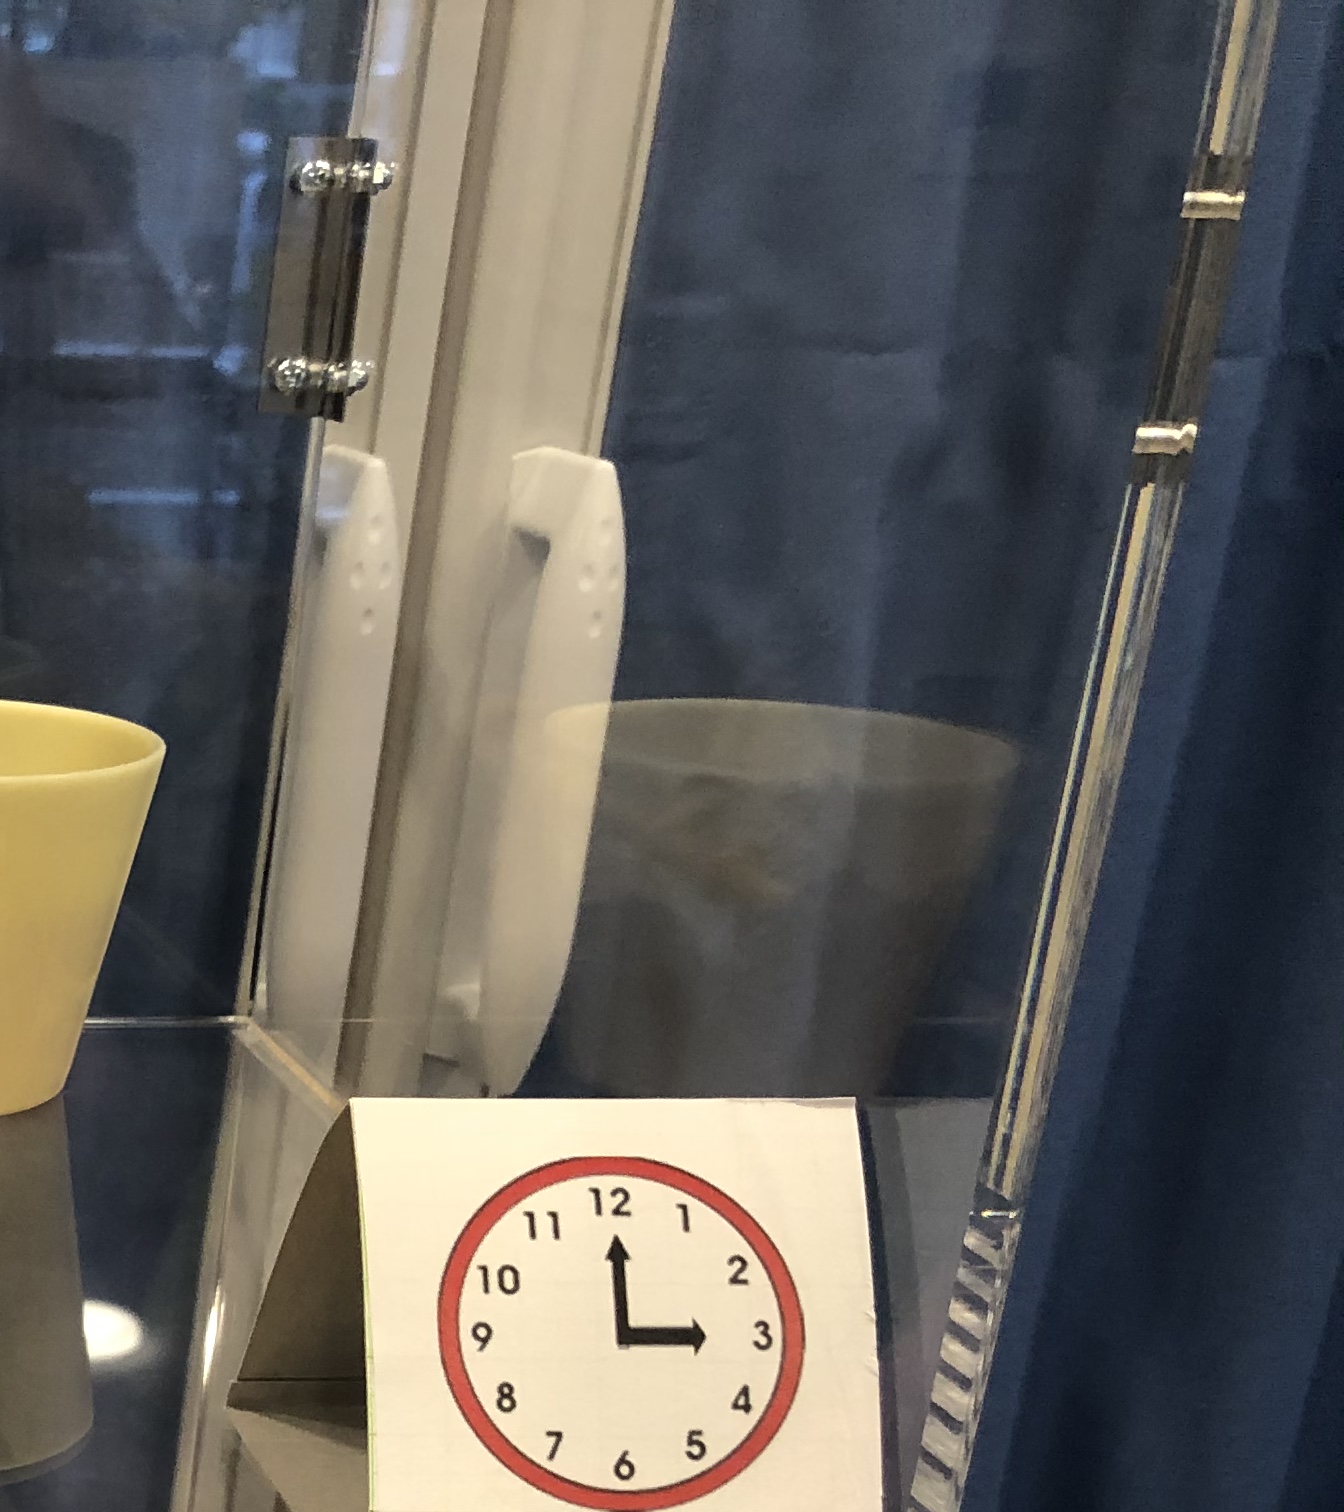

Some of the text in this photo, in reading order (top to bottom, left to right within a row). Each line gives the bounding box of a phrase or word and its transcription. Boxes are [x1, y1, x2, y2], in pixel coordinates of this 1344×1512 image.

[588, 1187, 632, 1218] 12
[675, 1203, 691, 1233] 1
[523, 1210, 561, 1241] 11
[477, 1264, 521, 1295] 10
[727, 1254, 749, 1286] 2
[471, 1321, 493, 1352] 9
[752, 1320, 773, 1351] 3
[496, 1381, 517, 1413] 8
[731, 1384, 753, 1415] 4
[545, 1430, 564, 1462] 7
[685, 1429, 707, 1461] 5
[613, 1449, 636, 1481] 6
